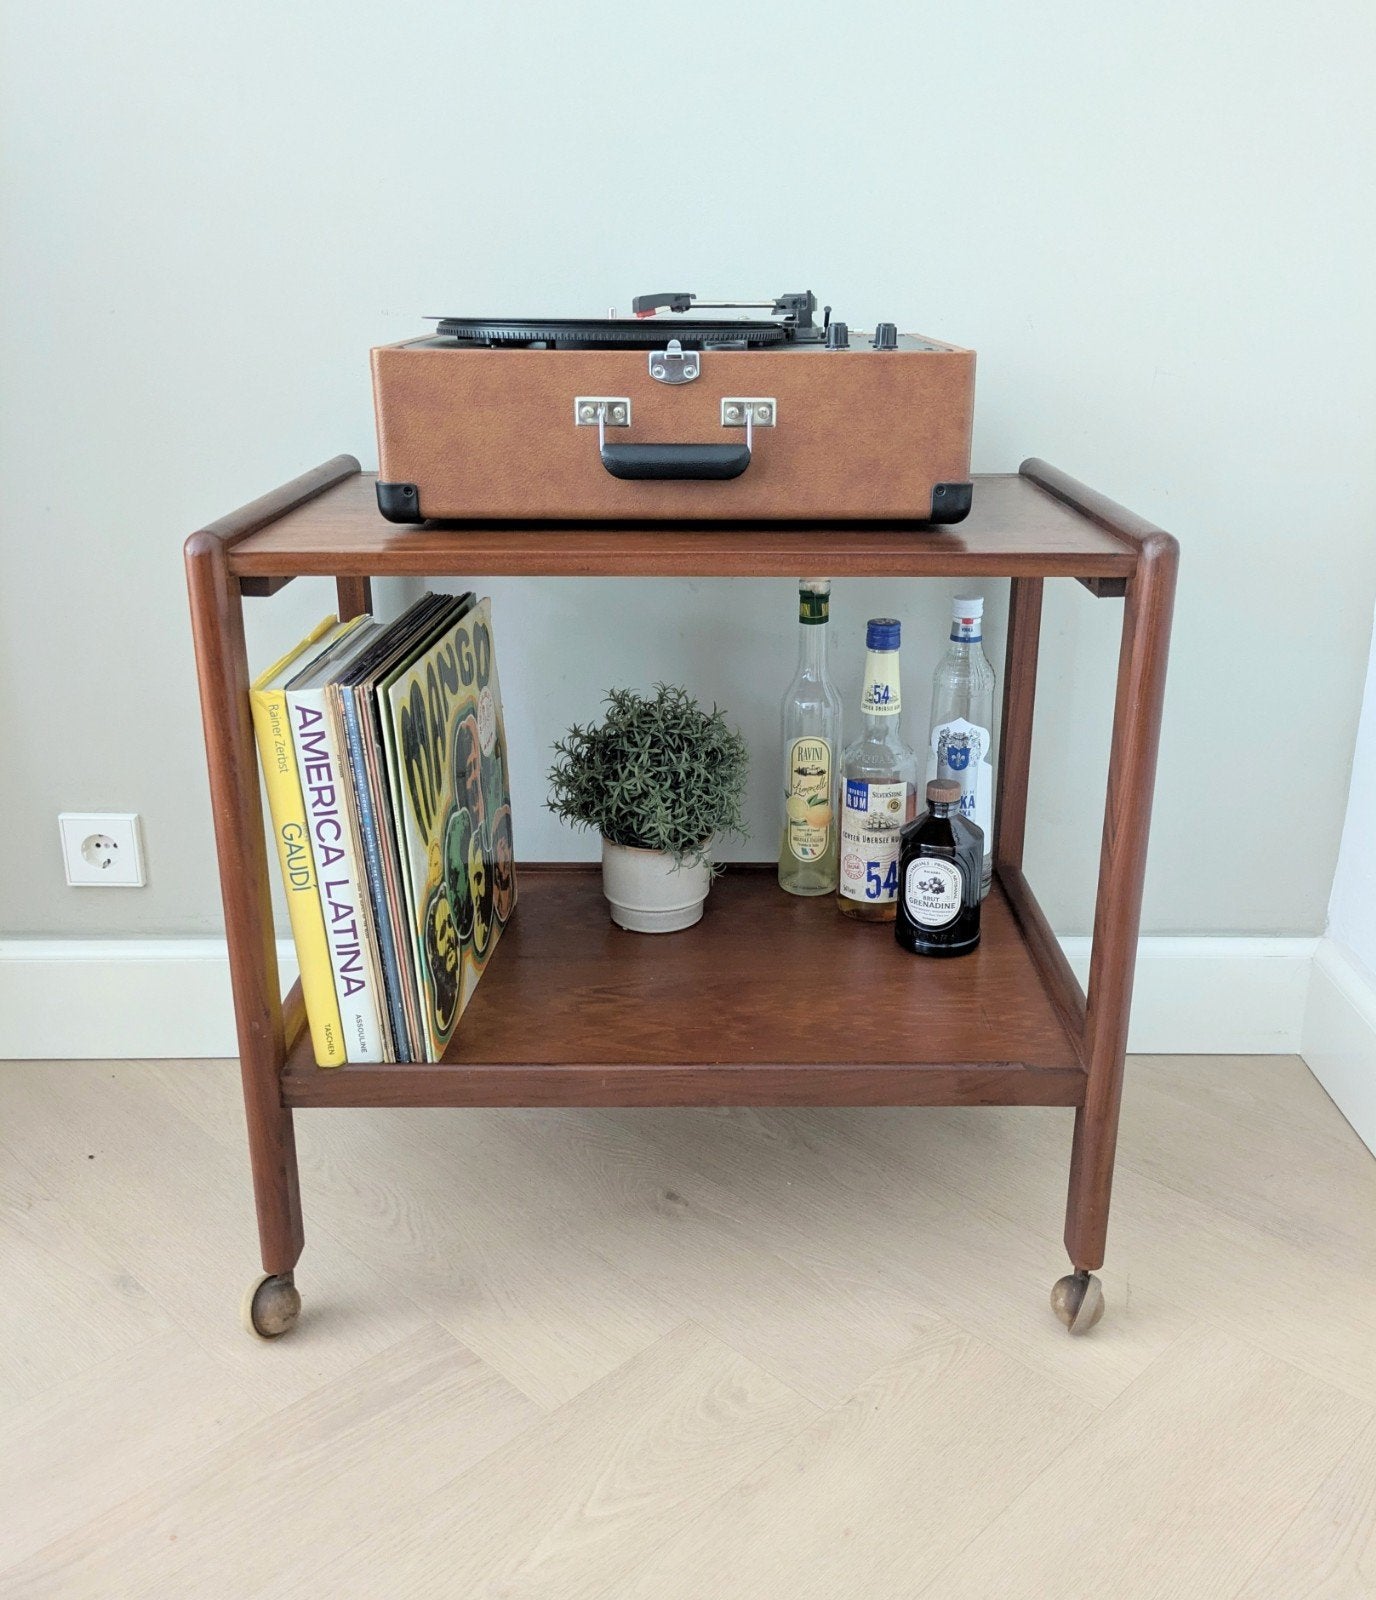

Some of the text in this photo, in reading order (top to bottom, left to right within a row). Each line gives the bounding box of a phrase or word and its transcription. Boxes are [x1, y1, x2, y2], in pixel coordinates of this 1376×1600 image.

[873, 684, 890, 705] 54
[268, 703, 289, 774] Rainer Zerbst
[401, 620, 491, 847] MANGO
[797, 746, 823, 762] RAVINI
[847, 793, 867, 810] RUM
[281, 822, 318, 892] GAUDÍ
[295, 704, 366, 998] AMERICA LATINA
[865, 860, 899, 899] 54
[908, 896, 956, 910] GRENADINE
[324, 1023, 335, 1056] TASCHEN
[355, 1013, 368, 1054] ASSOULINE
